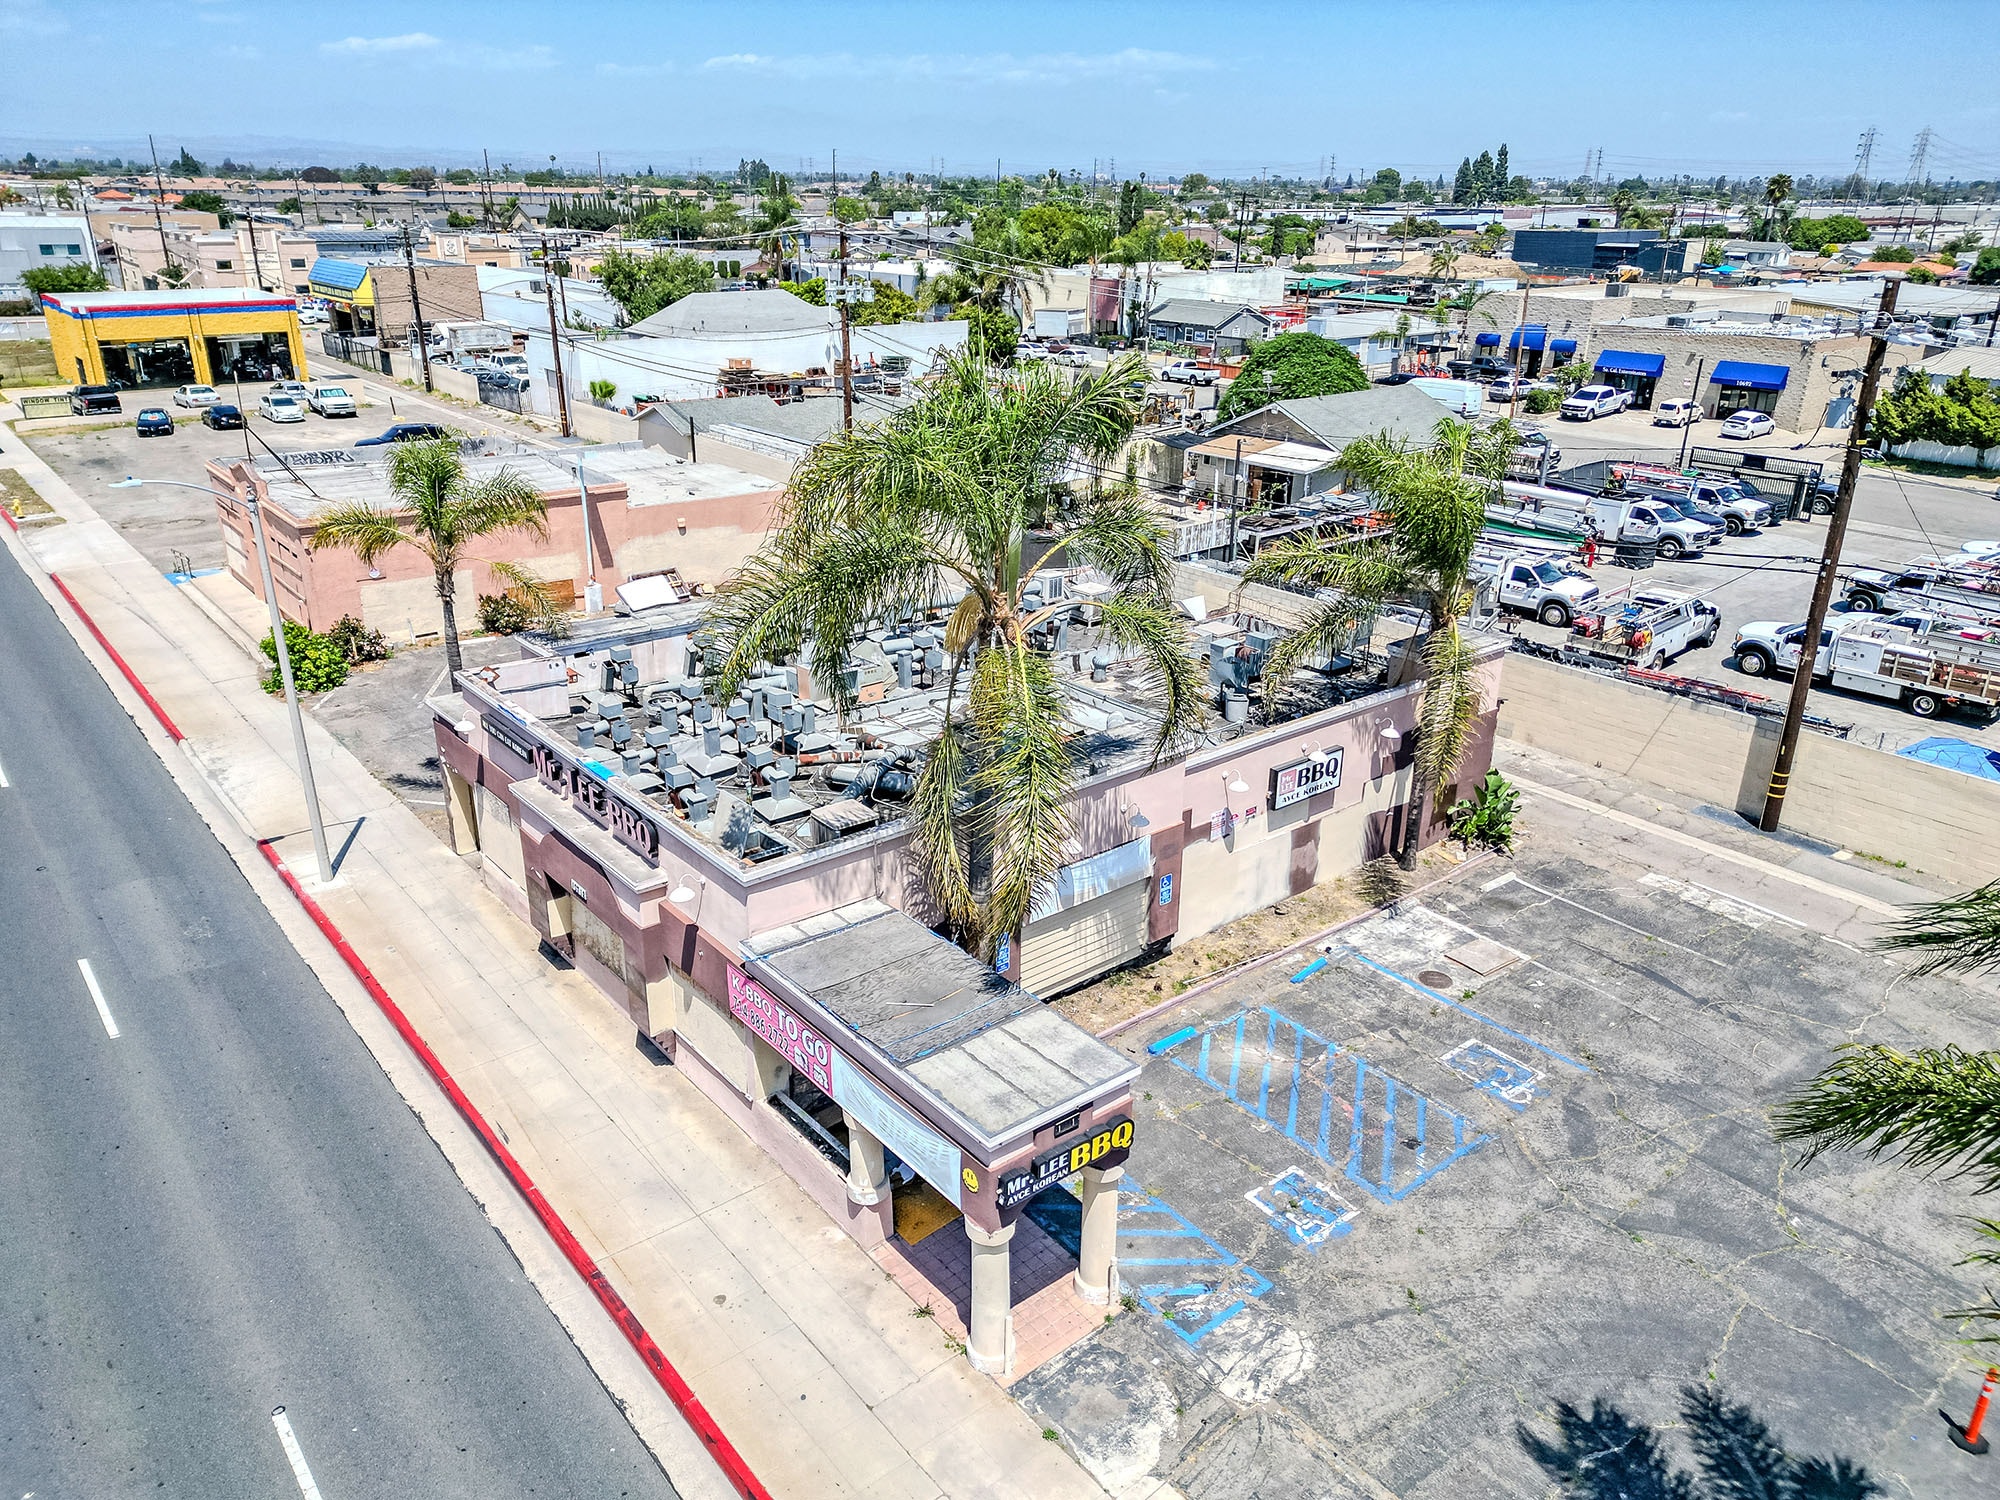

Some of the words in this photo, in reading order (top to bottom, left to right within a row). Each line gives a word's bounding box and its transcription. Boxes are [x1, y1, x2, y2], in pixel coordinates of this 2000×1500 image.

[1282, 793, 1300, 803] AYCE
[1303, 780, 1334, 796] KOREAN
[1297, 757, 1339, 788] BBQ
[606, 797, 659, 859] BBQ
[731, 973, 744, 995] K.
[745, 986, 772, 1020] BBQ
[774, 1003, 799, 1041] TO
[801, 1028, 828, 1066] GO
[749, 1008, 766, 1034] 886
[768, 1024, 790, 1054] 2722
[1070, 1121, 1133, 1172] BBQ
[1007, 1175, 1034, 1195] Mr.
[1039, 1152, 1069, 1178] LEE
[1007, 1188, 1031, 1206] AYCE
[1032, 1167, 1069, 1192] KOREAN
